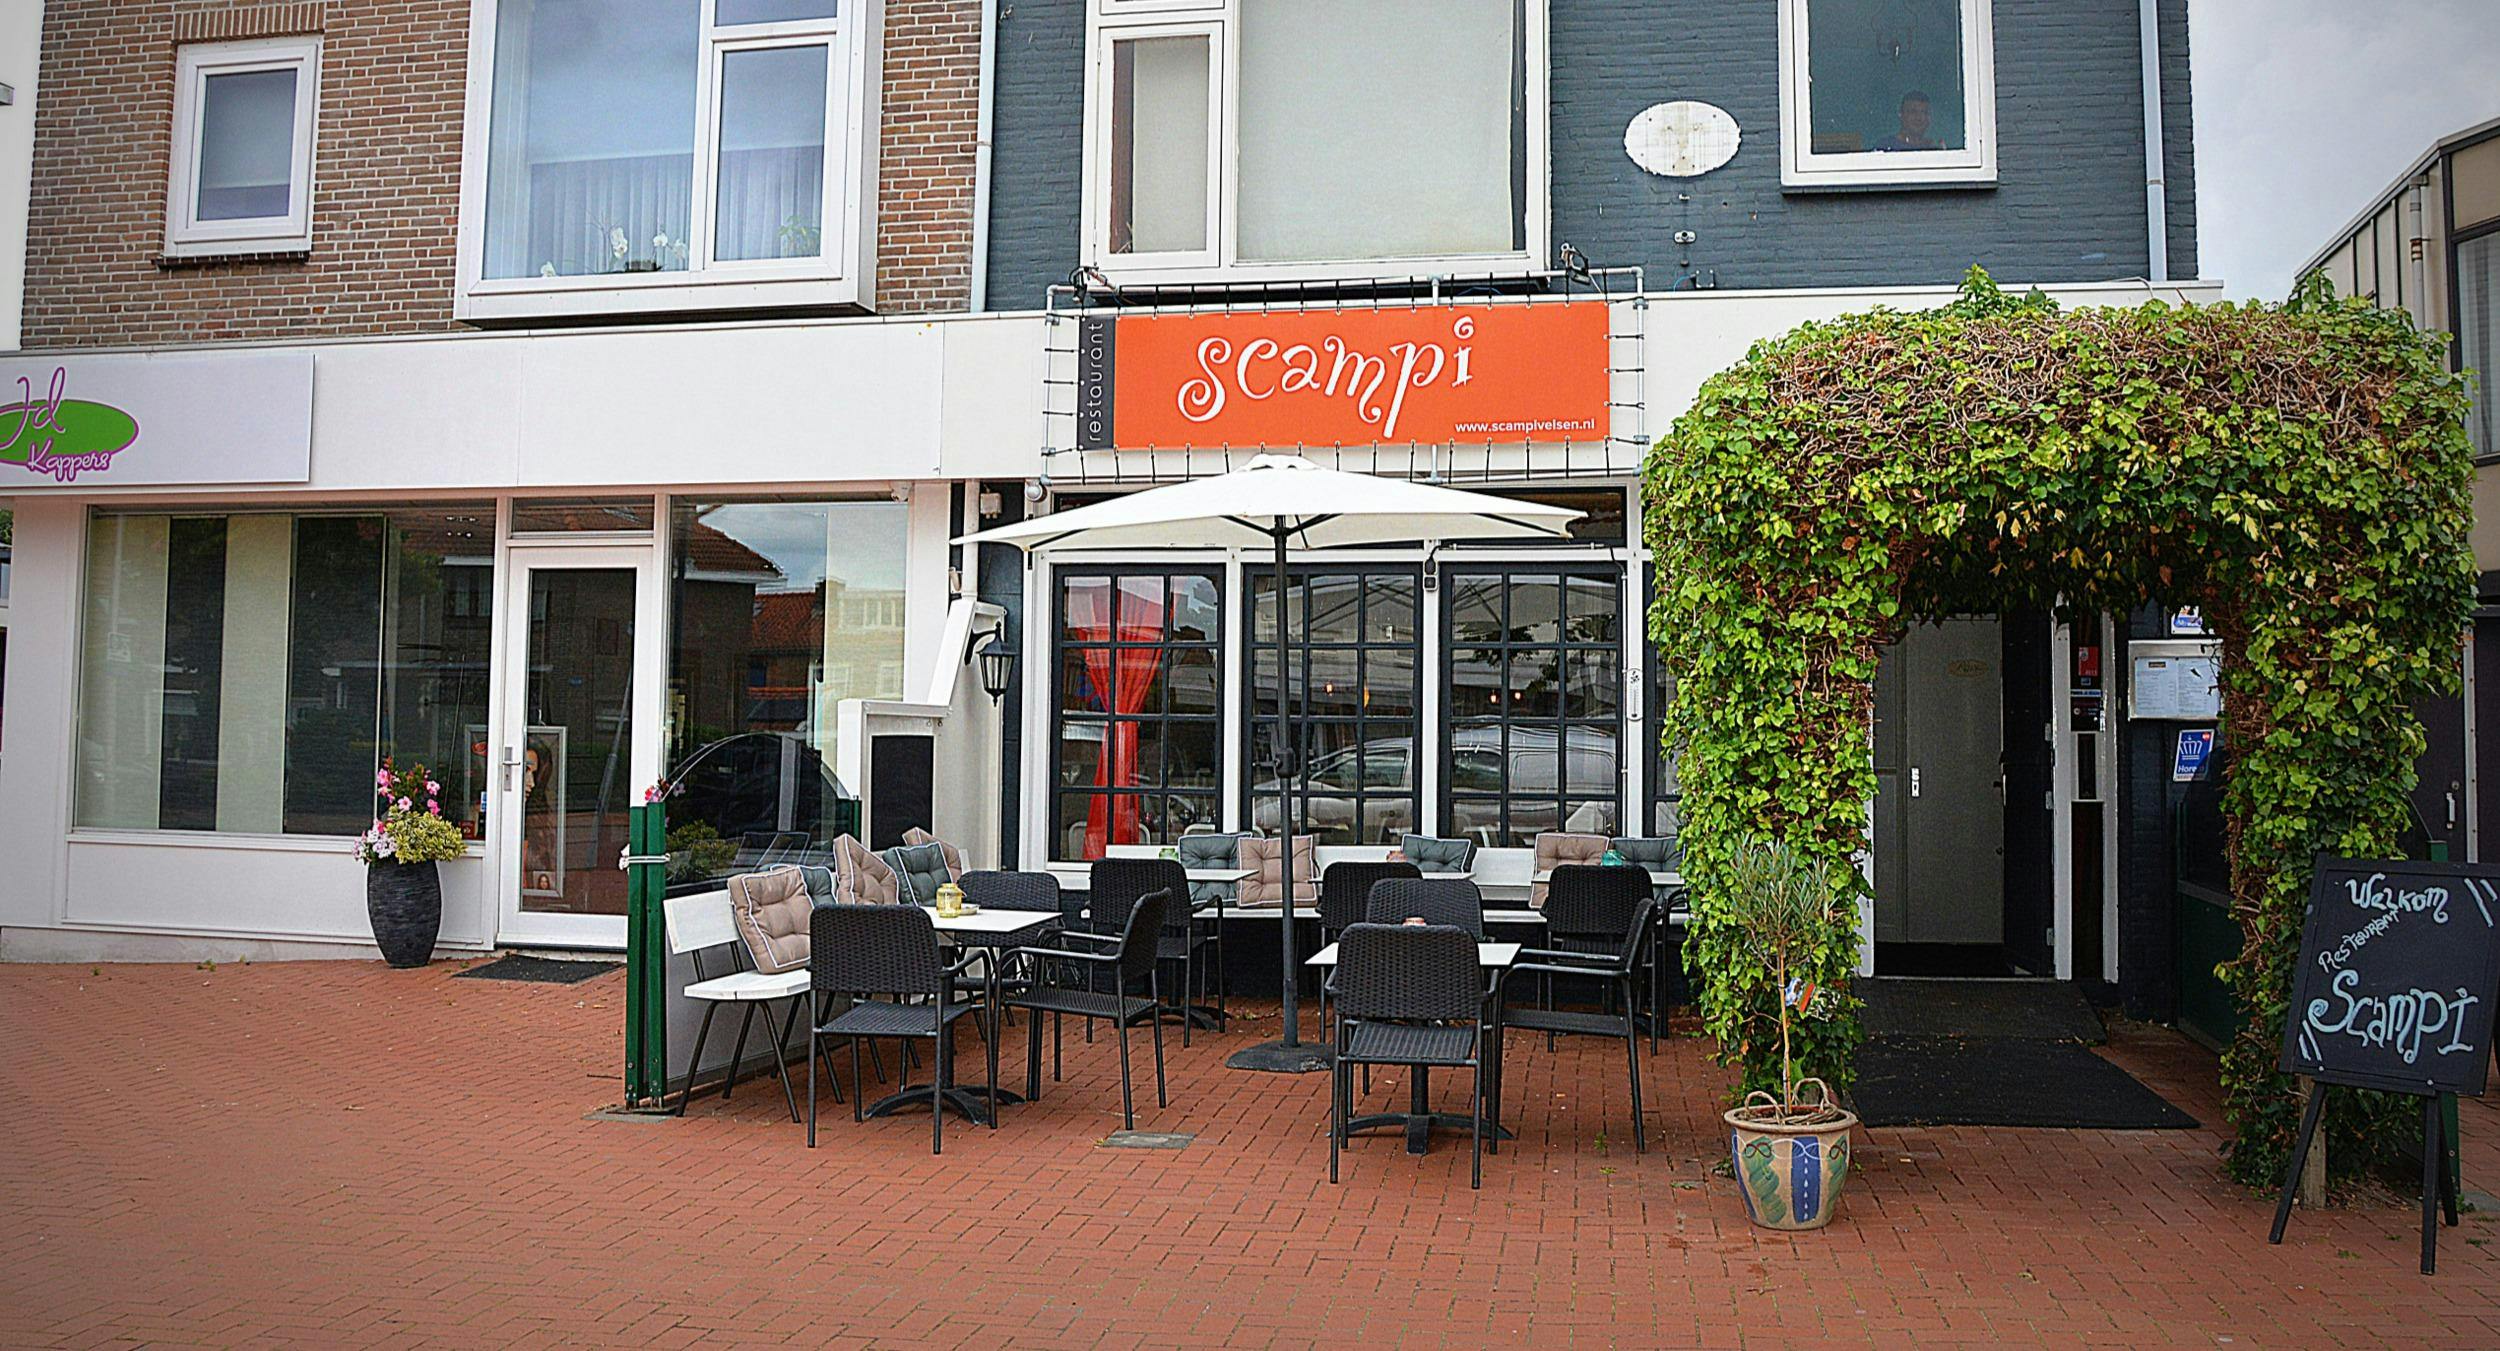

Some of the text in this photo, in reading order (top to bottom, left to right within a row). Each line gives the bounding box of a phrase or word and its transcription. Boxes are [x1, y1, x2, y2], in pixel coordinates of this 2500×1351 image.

[1089, 323, 1103, 442] restaurant
[1455, 418, 1595, 433] www.scampivelsen.nl
[27, 438, 111, 482] Kappers
